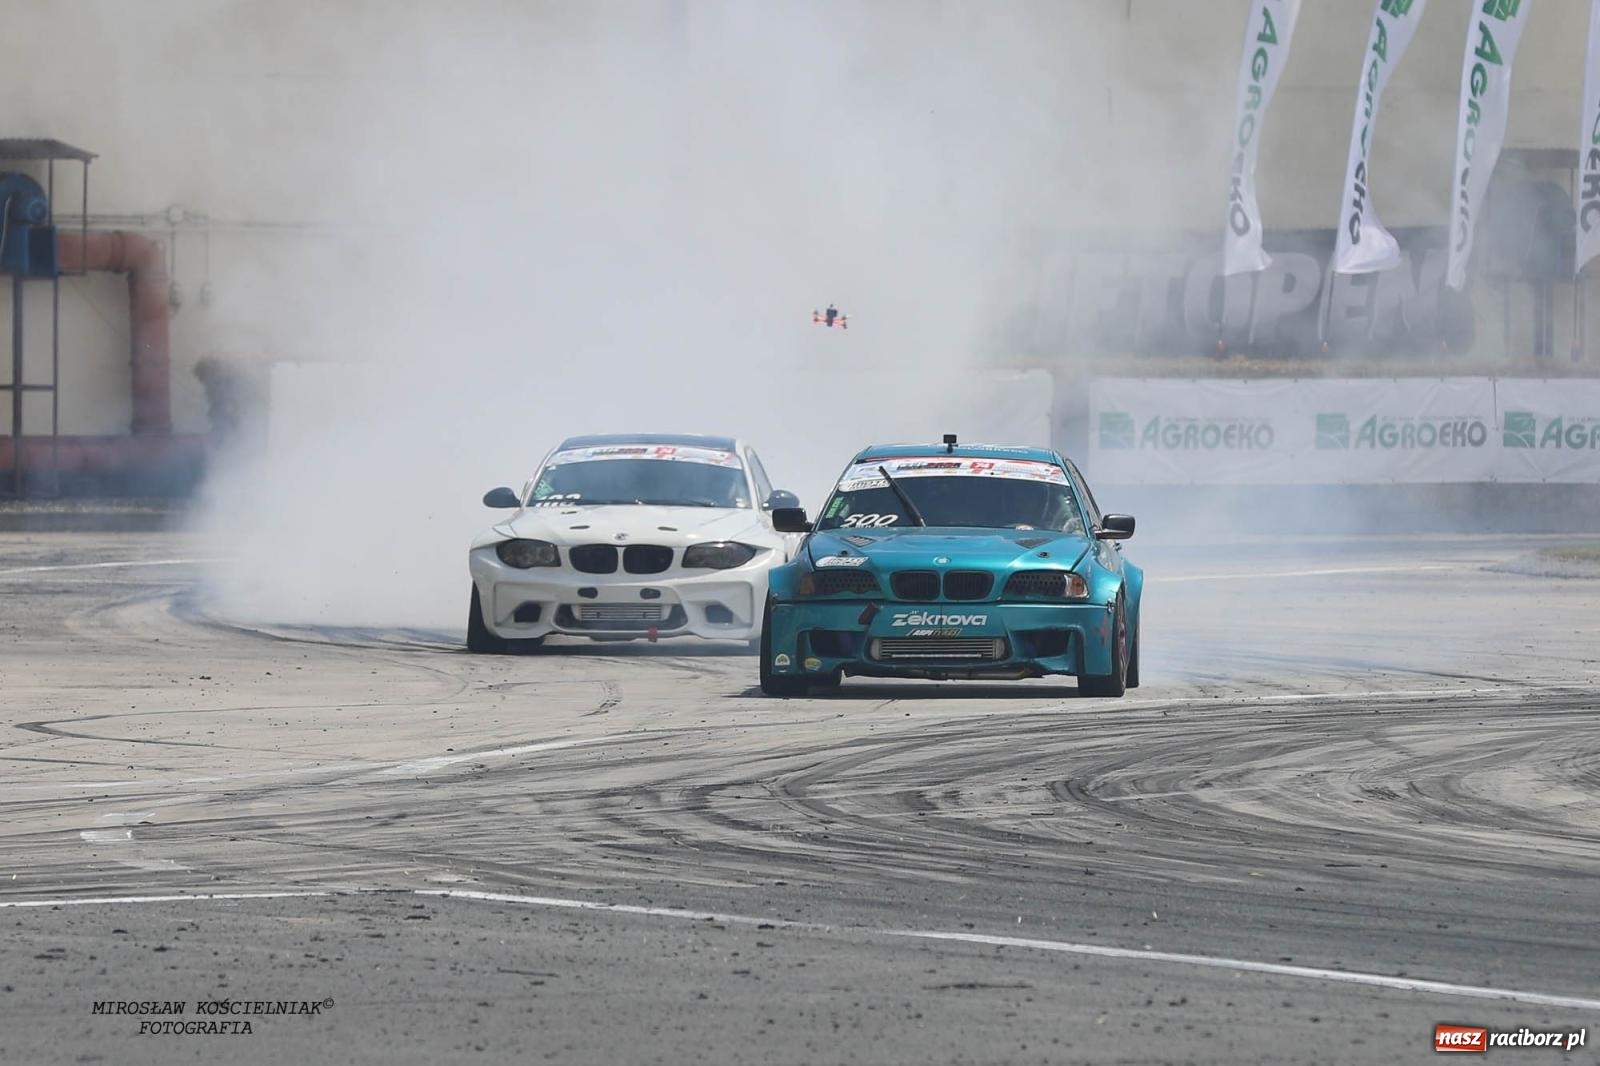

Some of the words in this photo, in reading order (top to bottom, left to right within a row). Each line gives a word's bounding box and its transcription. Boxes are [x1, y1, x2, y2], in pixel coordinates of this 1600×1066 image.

[1141, 415, 1274, 449] AGROEKO
[1354, 414, 1488, 449] AGROEKO
[840, 513, 899, 528] 500
